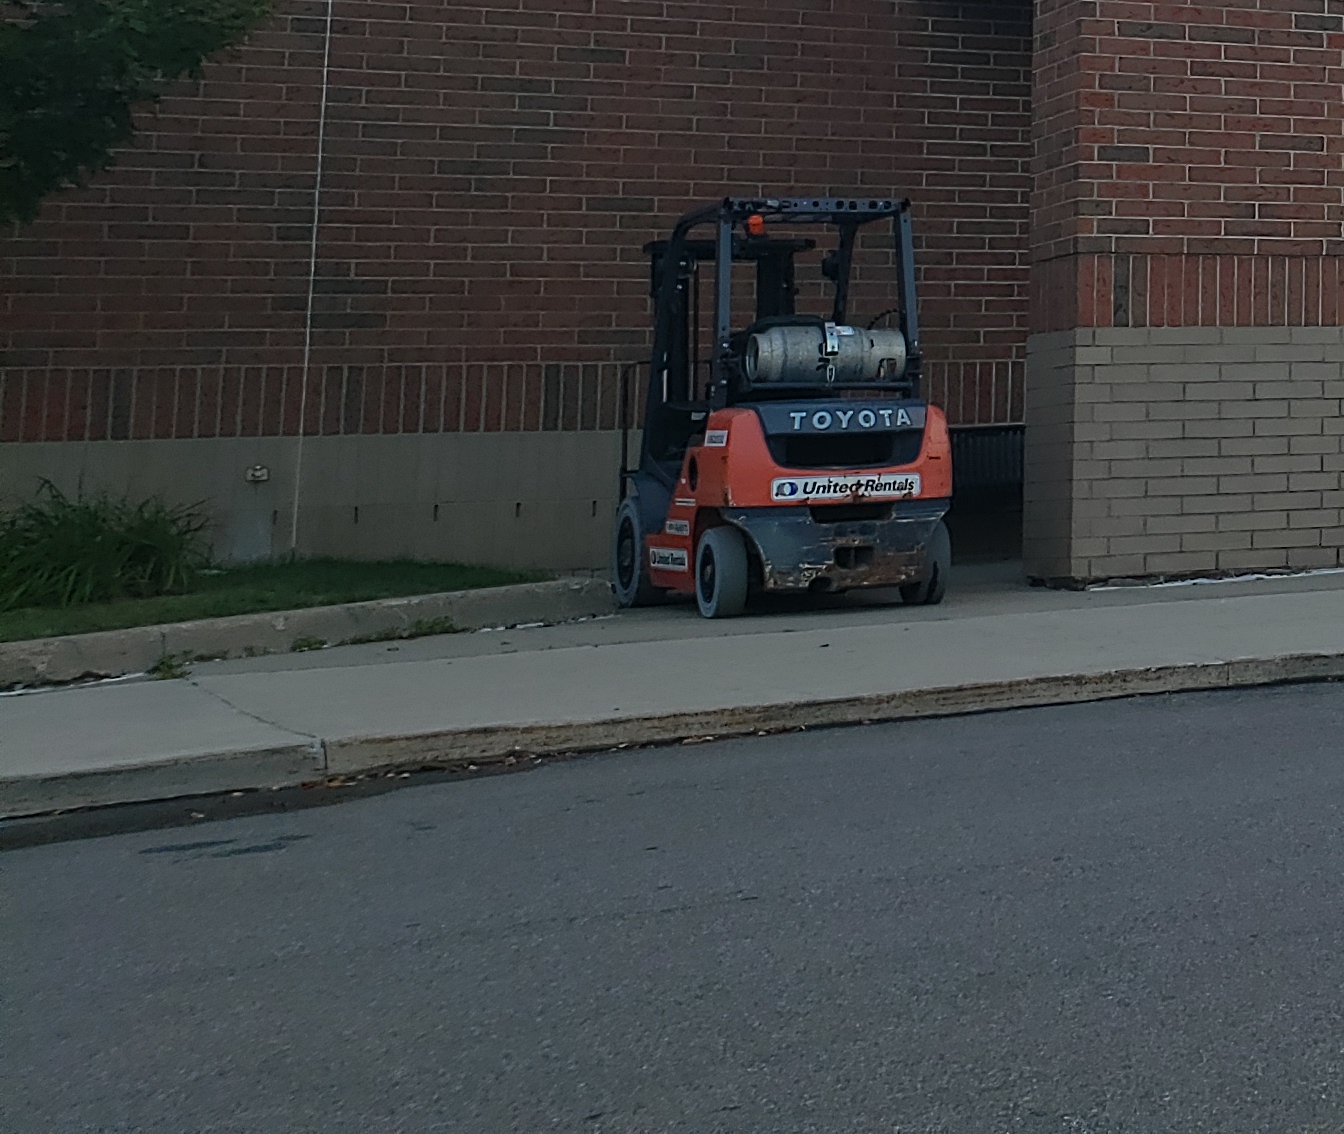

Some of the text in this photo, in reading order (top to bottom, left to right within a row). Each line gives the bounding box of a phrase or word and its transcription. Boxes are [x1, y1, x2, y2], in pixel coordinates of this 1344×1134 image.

[789, 408, 913, 431] TOYOTA
[802, 478, 915, 496] United Rentals
